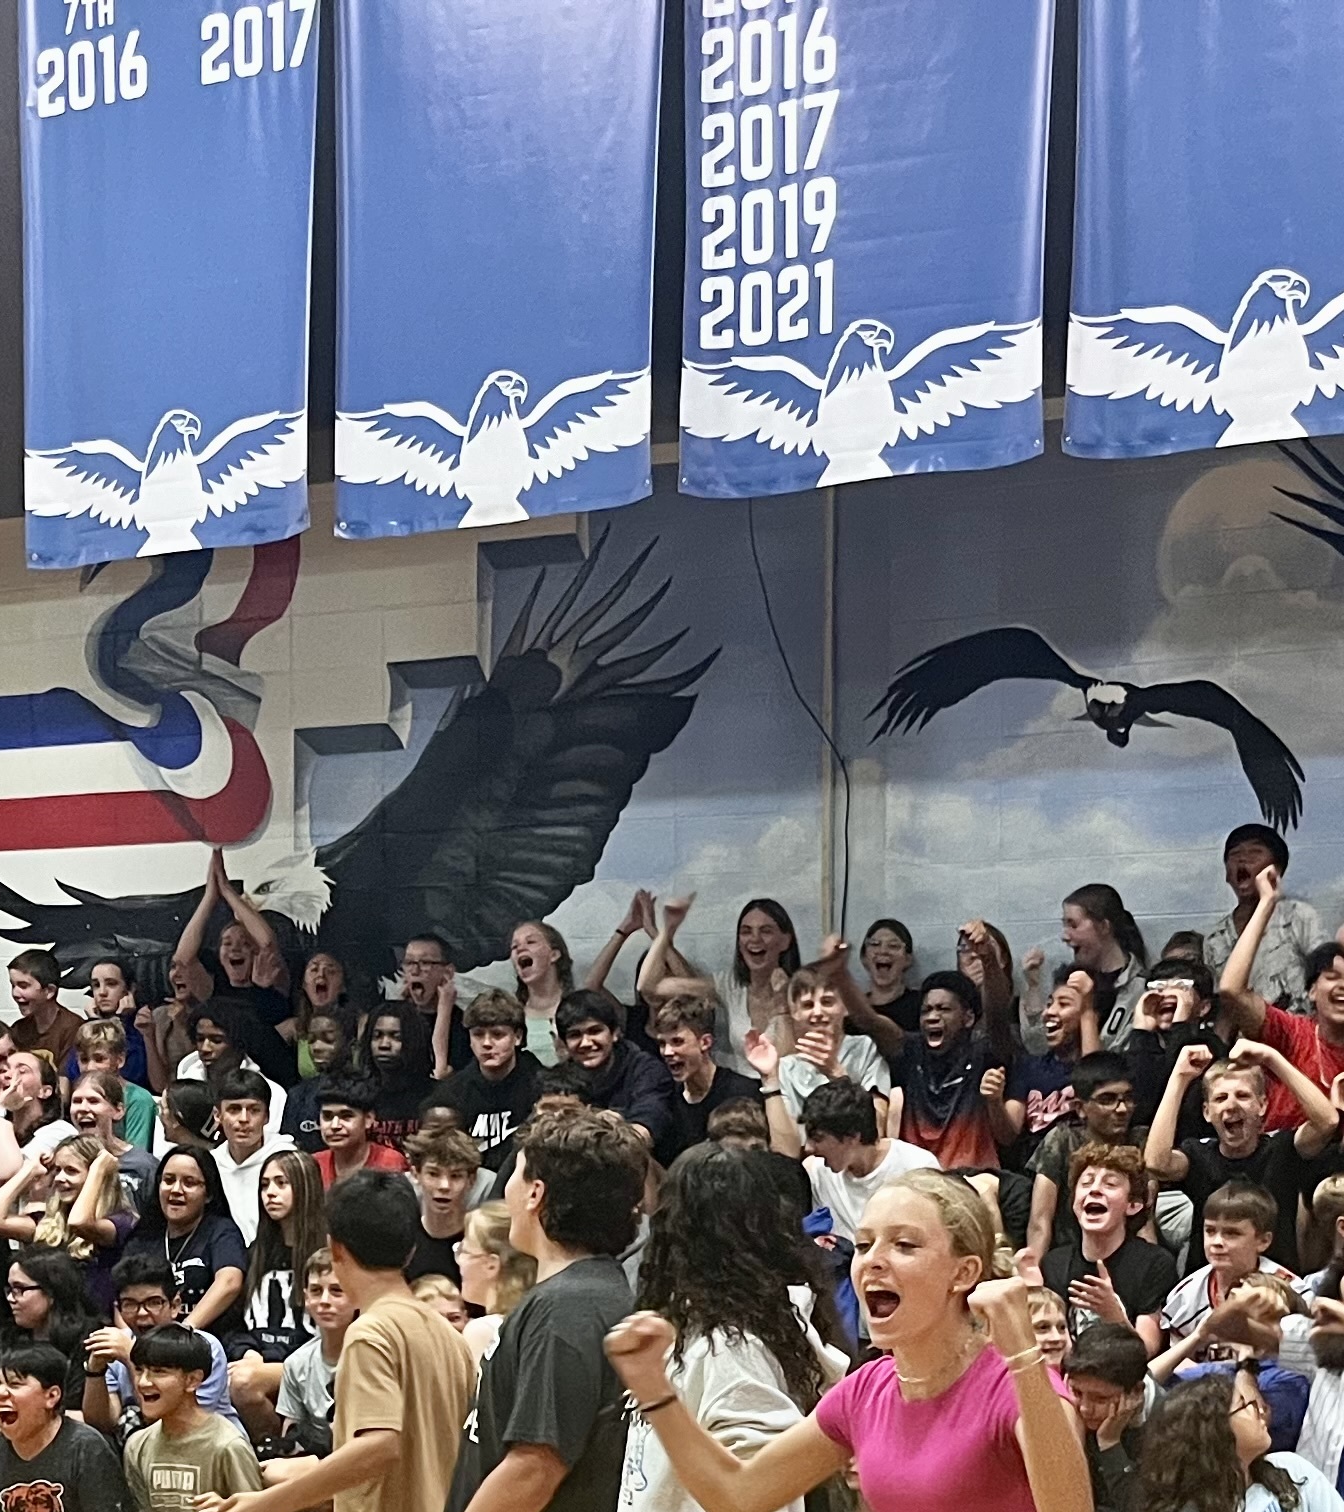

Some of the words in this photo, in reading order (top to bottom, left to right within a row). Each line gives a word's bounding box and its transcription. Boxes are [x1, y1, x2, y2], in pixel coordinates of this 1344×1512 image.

[36, 29, 148, 119] 2016
[200, 0, 316, 86] 2017
[701, 7, 837, 103] 2016
[701, 88, 840, 188] 2017
[701, 176, 837, 271] 2019
[700, 258, 835, 350] 2021
[153, 1469, 195, 1491] PUMA
